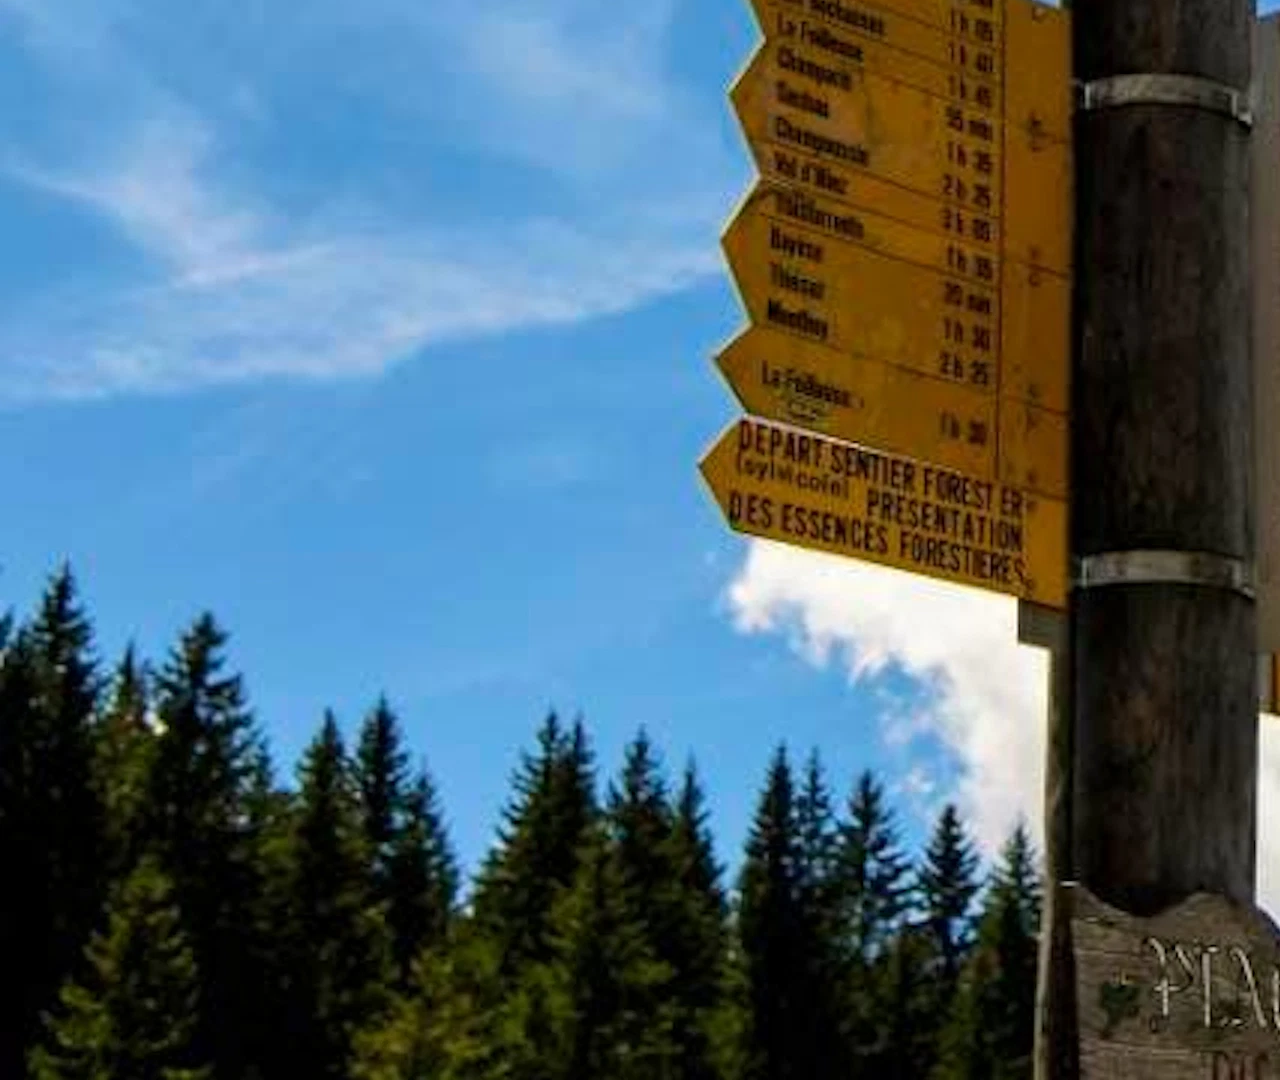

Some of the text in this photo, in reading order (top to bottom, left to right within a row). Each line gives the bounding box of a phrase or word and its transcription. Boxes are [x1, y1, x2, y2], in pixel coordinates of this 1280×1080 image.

[831, 444, 914, 495] SENTIER
[728, 490, 773, 529] DES
[782, 503, 890, 558] ESSENCES
[867, 486, 1023, 553] PRESENTATION
